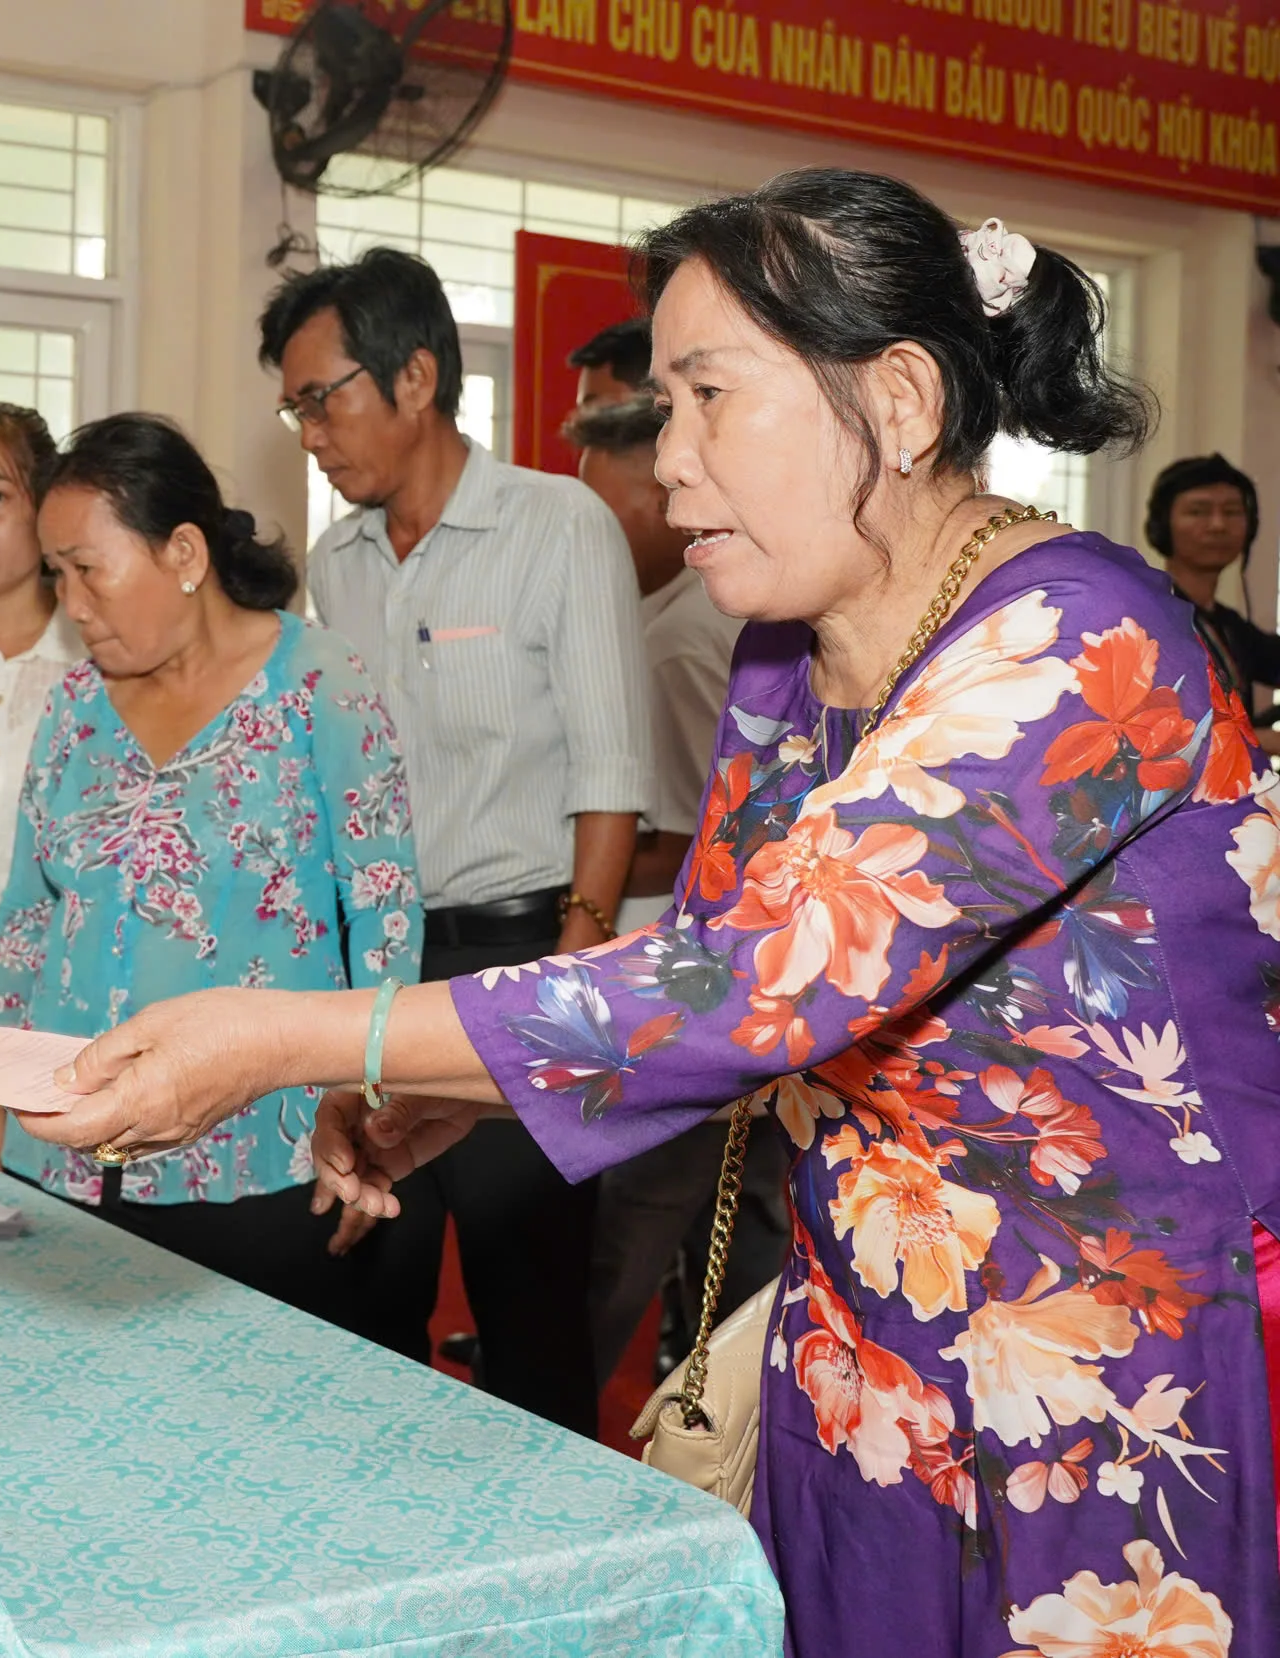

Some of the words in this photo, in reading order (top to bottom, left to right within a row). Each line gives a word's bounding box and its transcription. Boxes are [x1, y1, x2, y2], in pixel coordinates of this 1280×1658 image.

[772, 18, 863, 97] NHÂN
[872, 34, 936, 112] DÂN
[945, 42, 1005, 125] BẦU
[1012, 62, 1068, 138] VÀO
[1076, 74, 1151, 153] QUỐC
[1157, 95, 1203, 173] HỘI
[1210, 108, 1277, 176] KHÓA
